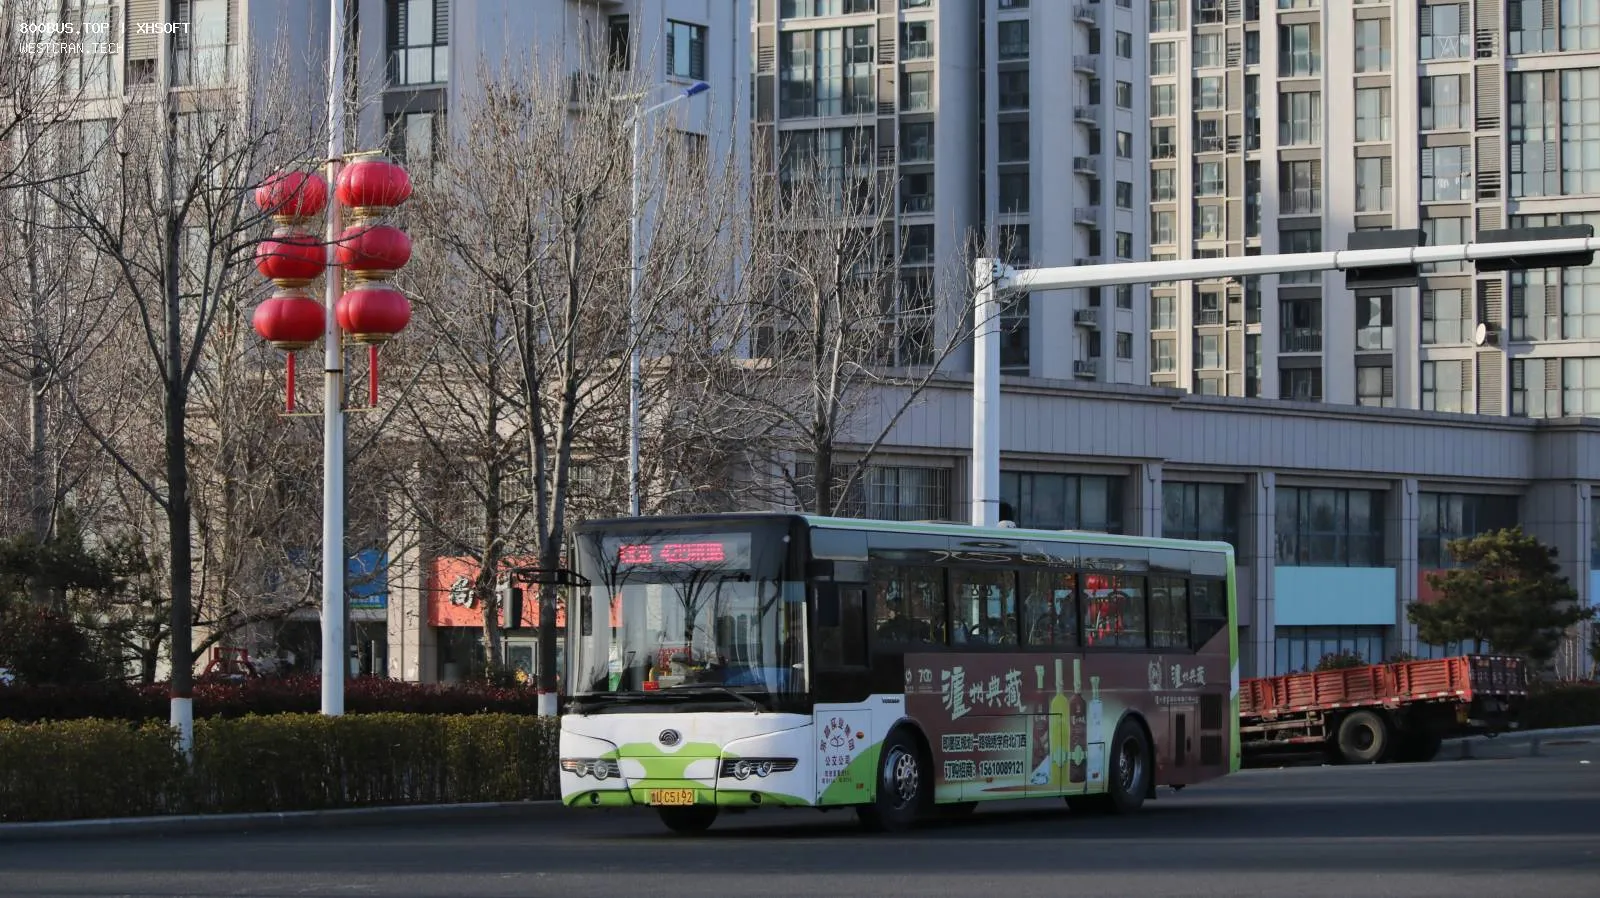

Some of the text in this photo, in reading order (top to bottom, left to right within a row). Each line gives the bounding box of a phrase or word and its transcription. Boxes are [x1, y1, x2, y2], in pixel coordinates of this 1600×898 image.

[941, 666, 1027, 720] 泸州典藏
[825, 754, 850, 766] 公交公司
